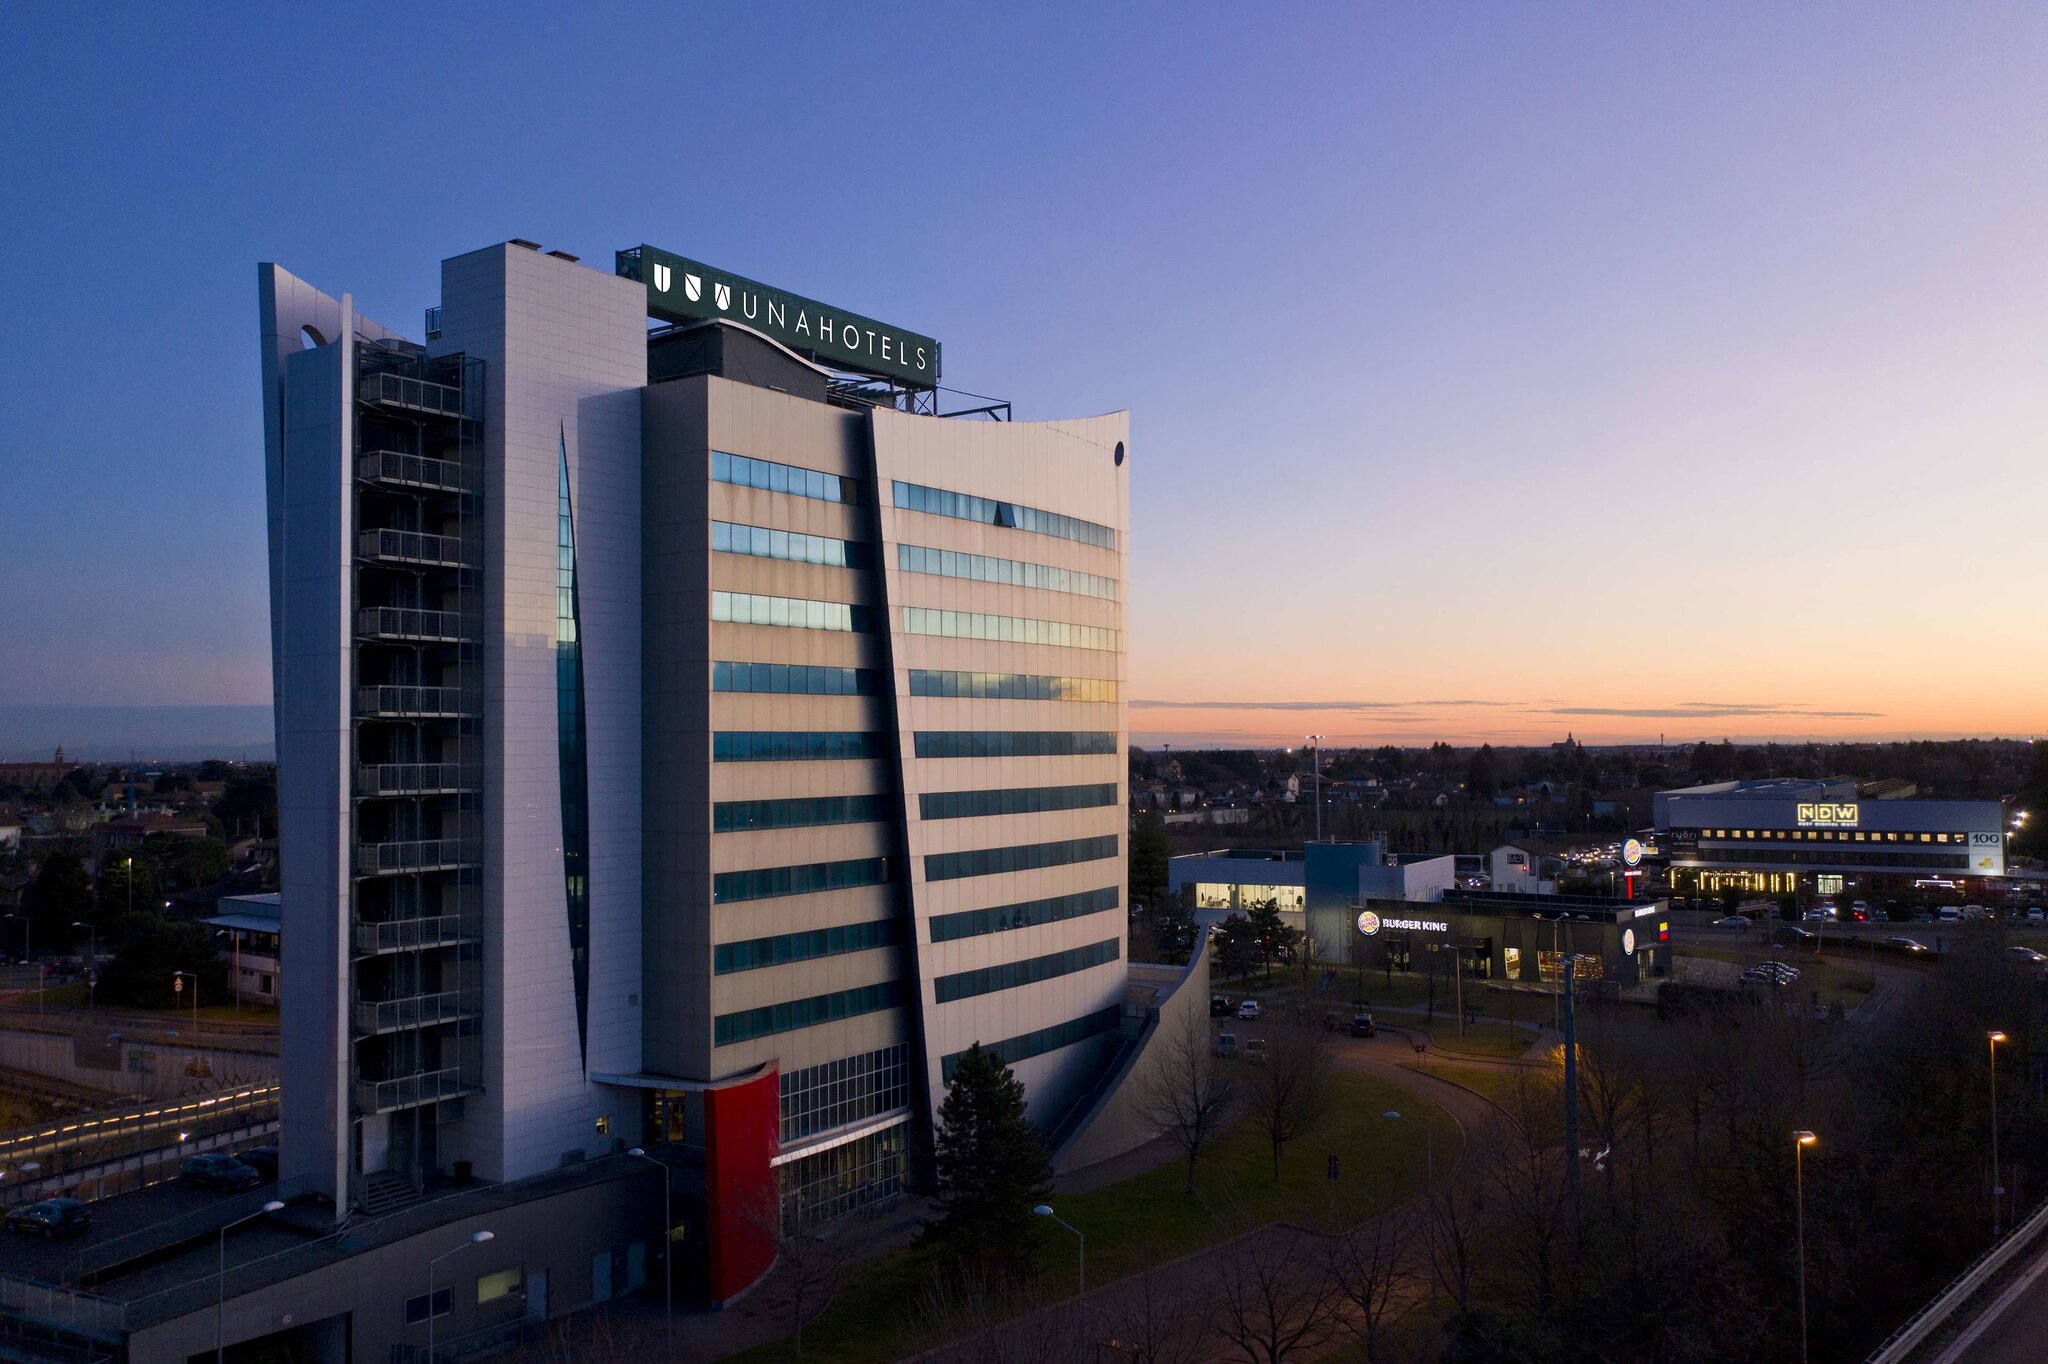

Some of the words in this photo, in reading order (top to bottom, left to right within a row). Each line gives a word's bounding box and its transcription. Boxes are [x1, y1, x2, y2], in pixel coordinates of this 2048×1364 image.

[743, 291, 926, 370] UNAHOTELS
[1801, 807, 1854, 819] NDW
[1972, 833, 2000, 843] 100
[1383, 918, 1421, 930] BURGER
[1423, 921, 1447, 931] KING
